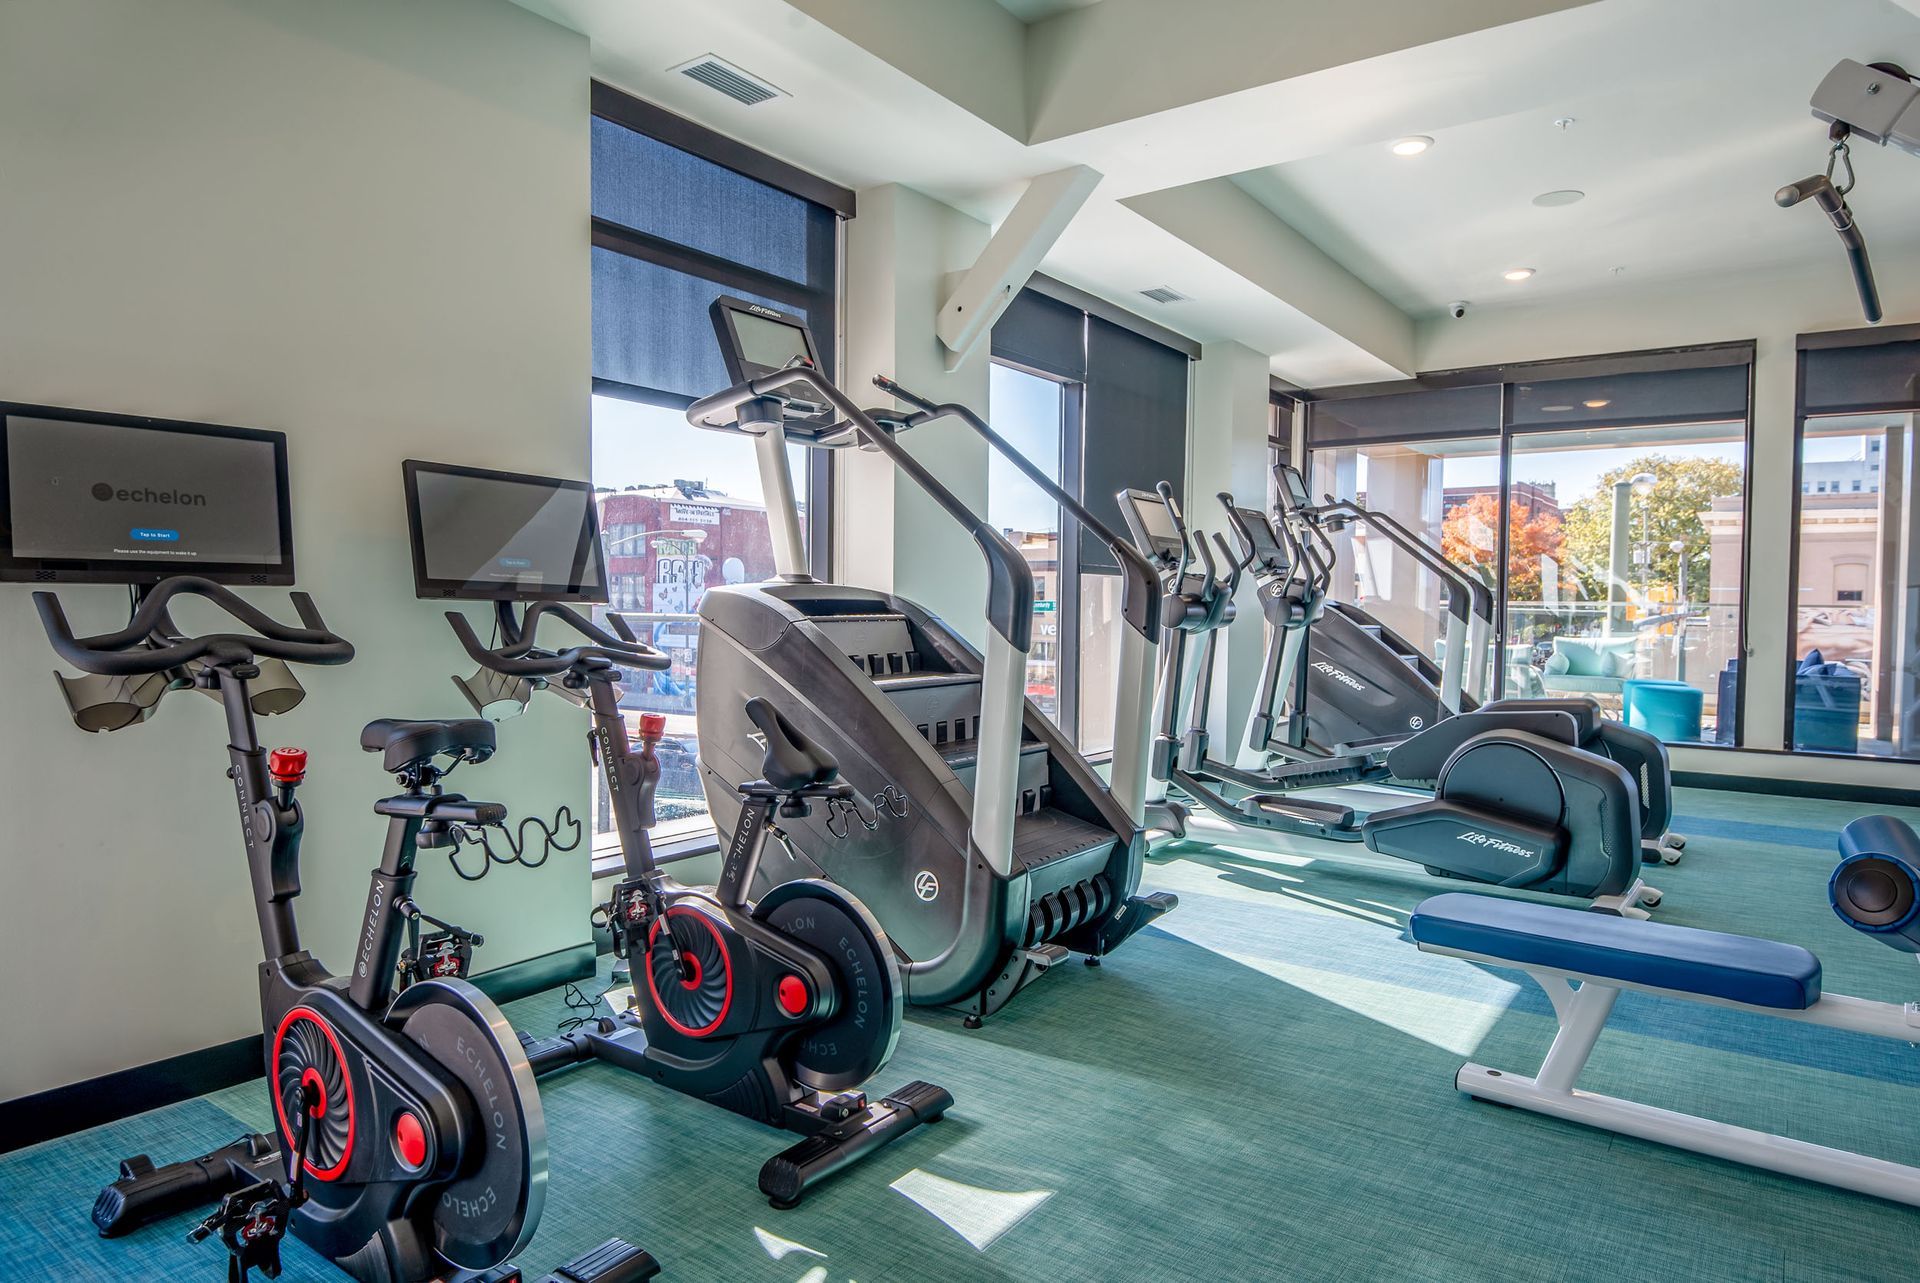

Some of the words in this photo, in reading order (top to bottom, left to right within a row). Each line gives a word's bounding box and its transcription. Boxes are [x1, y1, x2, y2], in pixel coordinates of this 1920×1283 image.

[116, 487, 206, 506] echelon
[1328, 669, 1366, 691] Fitness
[601, 727, 620, 792] CONNECT
[235, 764, 255, 849] CONNECT
[1456, 831, 1487, 845] Life
[1483, 838, 1535, 858] Fitness
[361, 879, 385, 963] ECHELON
[838, 936, 868, 1029] ECHELON
[456, 1036, 507, 1150] ECHELON
